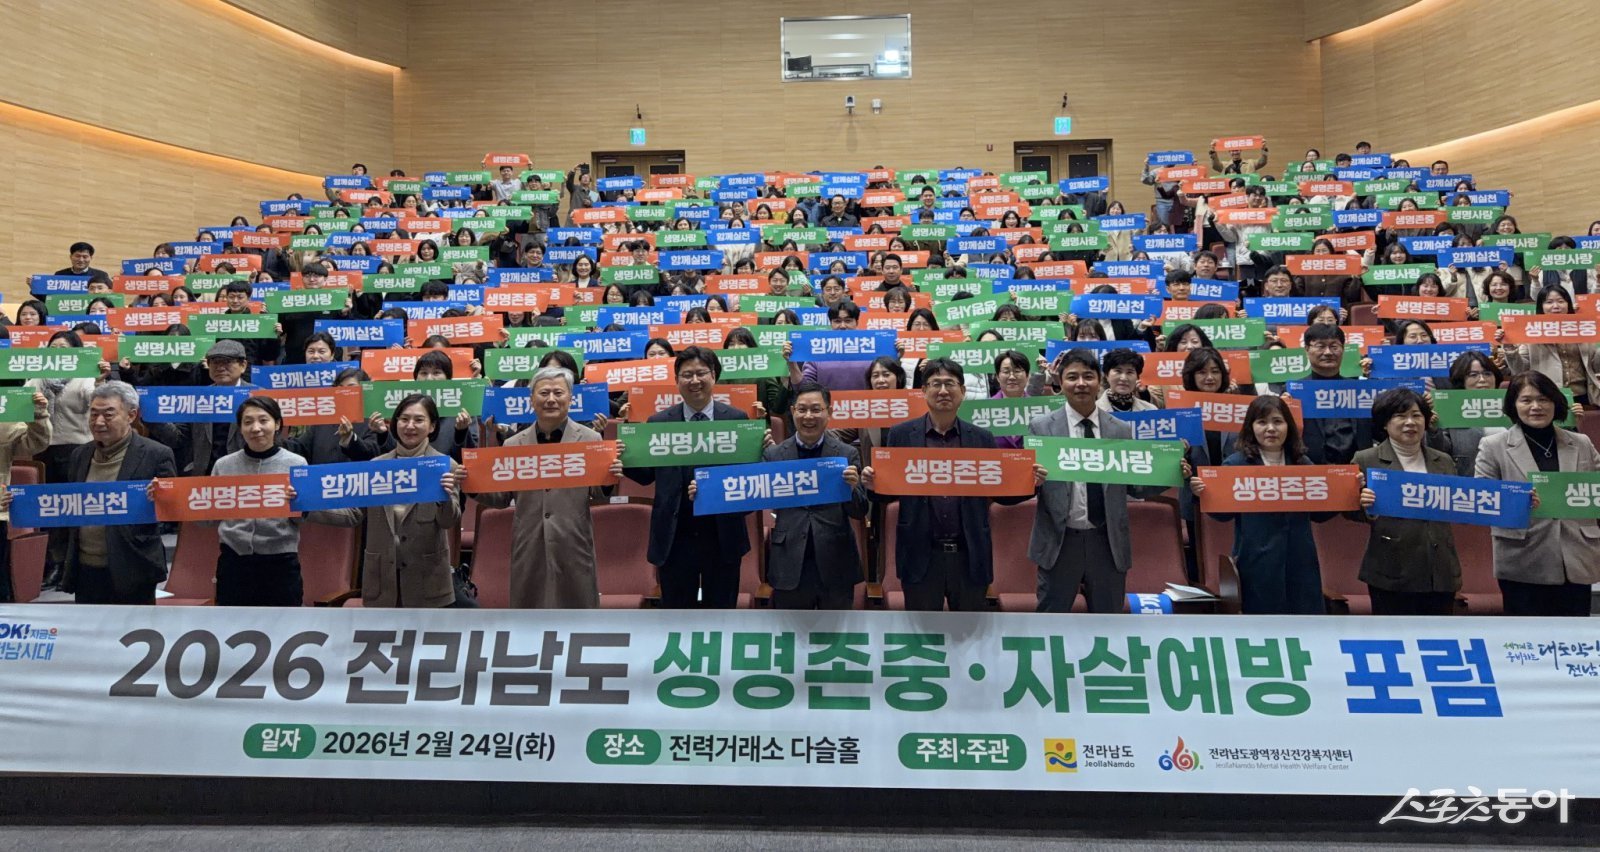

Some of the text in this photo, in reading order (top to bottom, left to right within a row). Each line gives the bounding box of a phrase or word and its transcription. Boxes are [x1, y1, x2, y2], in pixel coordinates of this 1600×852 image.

[1224, 140, 1253, 148] 생명존중
[1168, 170, 1198, 178] 생명존중
[1387, 172, 1421, 180] 함께실천
[393, 183, 420, 191] 생명사랑
[1069, 180, 1099, 189] 함께실천
[1193, 181, 1225, 190] 생명존중
[1311, 184, 1343, 192] 생명존중
[1365, 183, 1399, 192] 생명사랑
[794, 186, 821, 194] 생명사랑
[1024, 187, 1054, 195] 생명사랑
[521, 193, 549, 201] 생명사랑
[866, 195, 895, 203] 생명존중
[980, 195, 1009, 204] 생명존중
[492, 209, 521, 217] 생명사랑
[584, 210, 615, 219] 생명존중
[635, 209, 665, 217] 생명사랑
[679, 210, 709, 218] 함께실천
[1229, 211, 1266, 220] 생명존중
[1338, 213, 1376, 222] 함께실천
[1452, 210, 1493, 219] 생명사랑
[272, 220, 303, 228] 생명존중
[463, 220, 495, 228] 생명사랑
[1101, 218, 1134, 226] 함께실천
[1285, 216, 1321, 226] 생명사랑
[1396, 214, 1434, 224] 생명존중
[364, 220, 396, 229] 함께실천
[408, 221, 440, 229] 생명존중
[558, 231, 591, 240] 함께실천
[717, 232, 750, 240] 함께실천
[783, 231, 816, 240] 생명사랑
[913, 227, 945, 236] 생명사랑
[243, 236, 279, 245] 생명존중
[664, 233, 696, 242] 생명사랑
[855, 238, 887, 246] 생명존중
[1061, 236, 1097, 246] 생명사랑
[1261, 237, 1301, 246] 생명사랑
[1496, 237, 1538, 248] 생명사랑
[293, 239, 328, 248] 생명사랑
[376, 243, 411, 252] 생명존중
[959, 240, 995, 250] 함께실천
[1145, 239, 1184, 248] 함께실천
[174, 246, 211, 255] 함께실천
[443, 250, 478, 259] 생명사랑
[671, 255, 710, 265] 함께실천
[1453, 252, 1499, 262] 함께실천
[1541, 253, 1593, 266] 생명사랑
[135, 262, 173, 272] 함께실천
[1301, 259, 1346, 270] 생명존중
[403, 266, 440, 275] 생명사랑
[614, 268, 653, 280] 생명사랑
[1034, 265, 1074, 276] 생명존중
[1107, 264, 1150, 276] 함께실천
[1373, 268, 1420, 280] 생명사랑
[501, 273, 540, 282] 함께실천
[125, 280, 169, 290] 생명존중
[373, 278, 415, 288] 생명사랑
[719, 279, 758, 289] 생명존중
[282, 294, 332, 307] 생명사랑
[487, 293, 536, 306] 생명존중
[1089, 299, 1144, 314] 함께실천
[1396, 300, 1449, 315] 생명존중
[125, 312, 181, 326] 생명존중
[613, 312, 664, 325] 함께실천
[205, 320, 260, 332] 생명사랑
[426, 322, 484, 338] 생명존중
[1525, 320, 1597, 337] 생명존중
[328, 327, 384, 341] 함께실천
[667, 329, 722, 344] 생명존중
[134, 341, 196, 356] 생명사랑
[573, 337, 631, 354] 함께실천
[810, 337, 875, 354] 함께실천
[8, 355, 79, 372] 생명사랑
[720, 354, 769, 371] 명사랑
[270, 370, 336, 388] 함께실천
[606, 365, 668, 384] 생명존중
[157, 394, 233, 415] 함께실천
[275, 396, 336, 417] 명존중
[832, 399, 909, 419] 생명존중
[649, 431, 738, 456] 생명사랑
[1057, 447, 1153, 474] 생명사랑
[491, 453, 586, 481] 생명존중
[905, 459, 1002, 486] 생명존중
[321, 469, 418, 499] 함께실천
[722, 470, 819, 501] 함께실천
[1232, 477, 1328, 501] 생명존중
[187, 484, 286, 510] 생명존중
[1401, 482, 1501, 515] 함께실천
[1565, 482, 1600, 507] 생명
[38, 492, 128, 517] 함께실천
[109, 629, 329, 701] 2026
[346, 630, 631, 706] 전라남도
[1339, 638, 1503, 717] 포럼
[1566, 662, 1600, 677] 전남
[261, 727, 301, 752] 일자
[322, 730, 555, 760] 2026년 2월 24일(화)
[604, 733, 645, 758] 장소
[669, 735, 860, 764] 전력거래소 다슬홀
[916, 738, 1009, 764] 주최·주관
[1082, 744, 1134, 759] 전라남도
[1209, 748, 1353, 761] 전라남도광역정신건강복지센터
[1084, 760, 1135, 768] JeollaNamdo
[1280, 762, 1301, 770] Health
